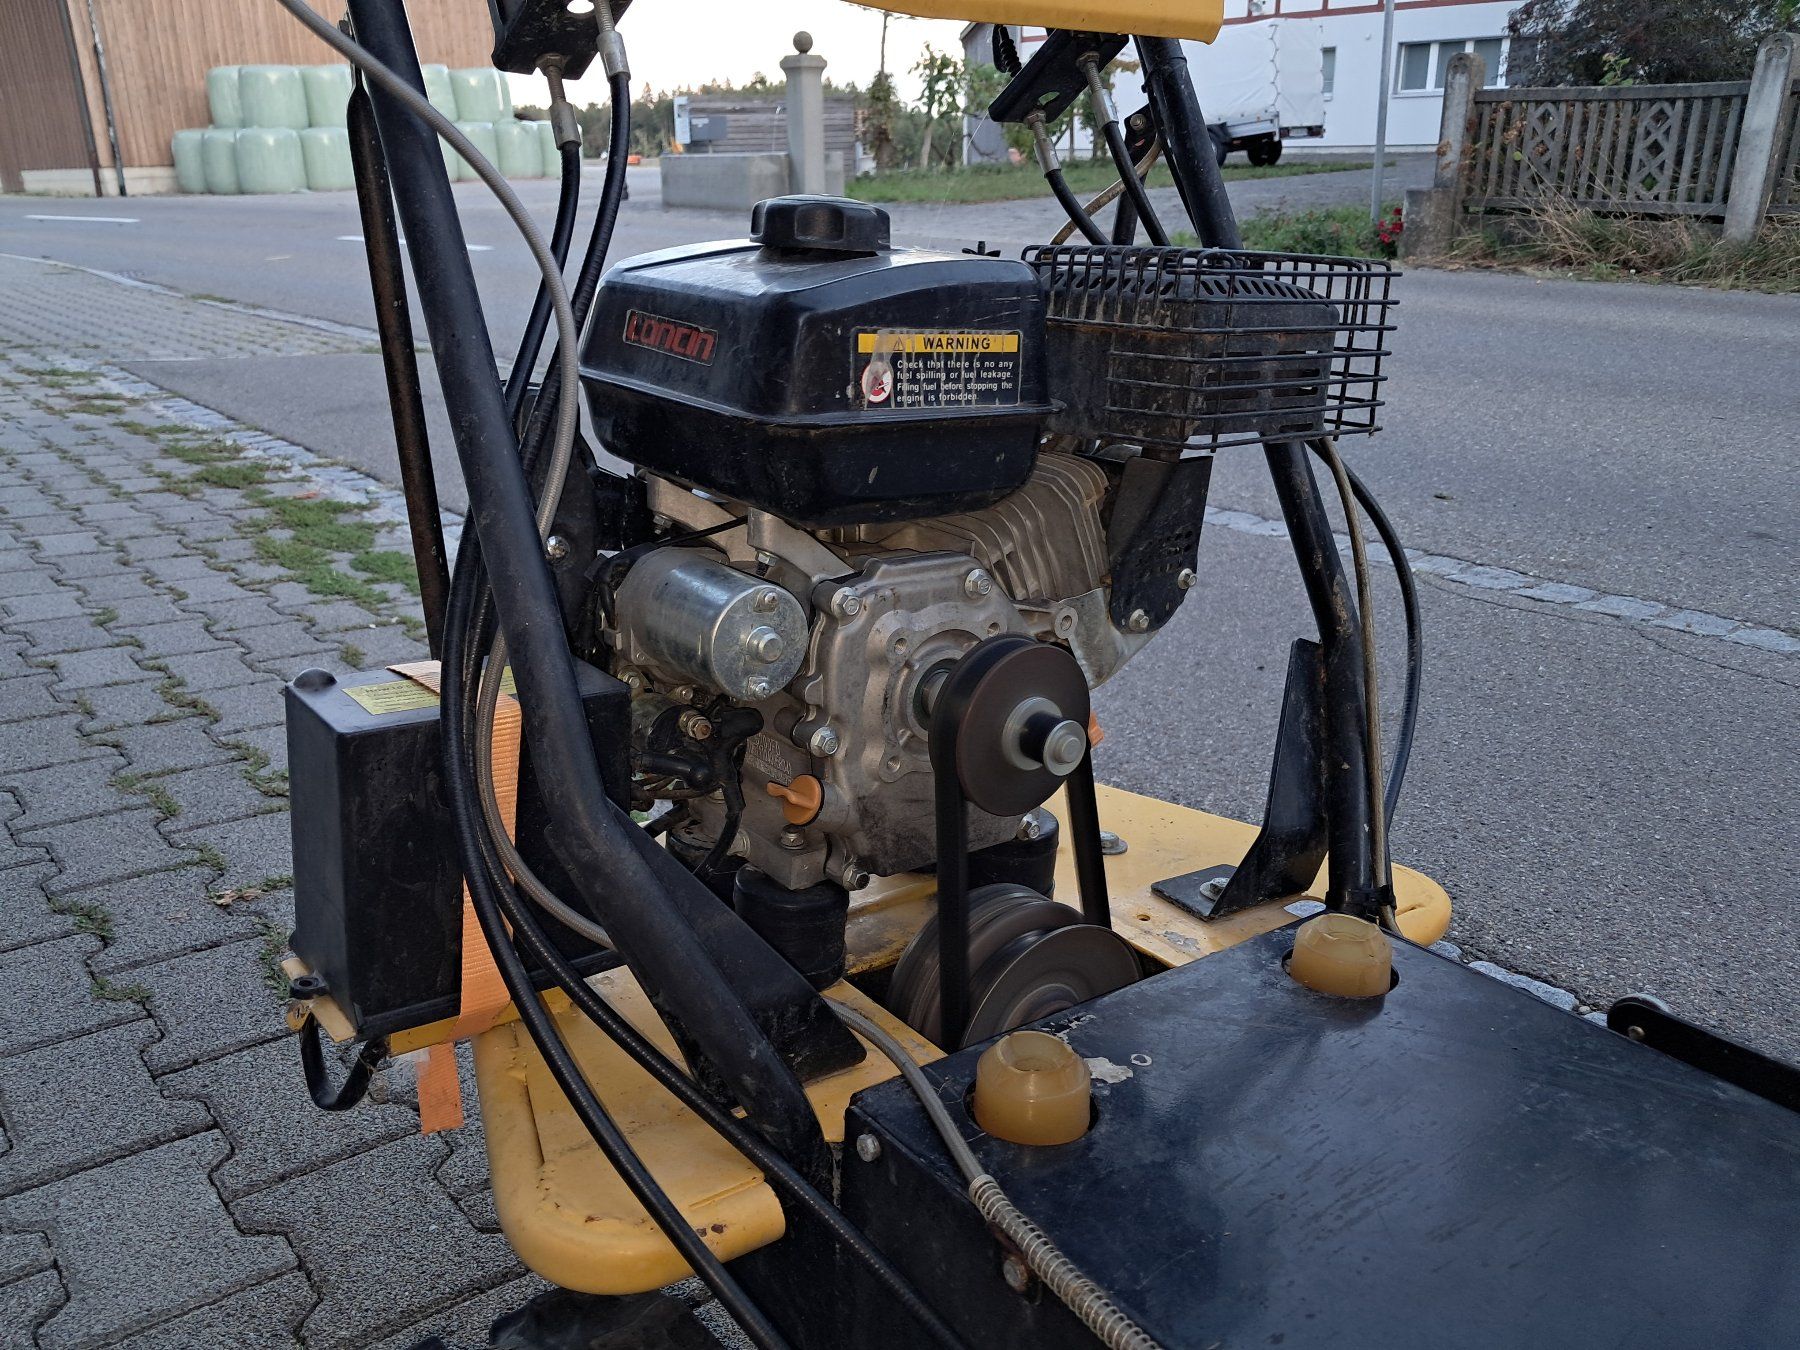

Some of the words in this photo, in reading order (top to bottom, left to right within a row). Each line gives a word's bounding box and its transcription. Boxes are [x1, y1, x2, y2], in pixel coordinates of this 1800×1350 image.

[923, 337, 991, 350] WARNING
[897, 360, 924, 369] Check
[927, 360, 944, 369] that
[947, 360, 970, 368] there
[973, 360, 980, 368] is
[998, 361, 1014, 370] any
[897, 371, 913, 380] fuel
[916, 370, 946, 381] spilling
[962, 370, 977, 379] fuel
[980, 370, 1013, 380] leakage.
[897, 383, 919, 393] Filling
[923, 382, 937, 391] fuel
[941, 382, 963, 390] before
[966, 382, 998, 392] stopping
[1002, 381, 1013, 390] the
[897, 394, 924, 404] engine
[928, 393, 935, 401] is
